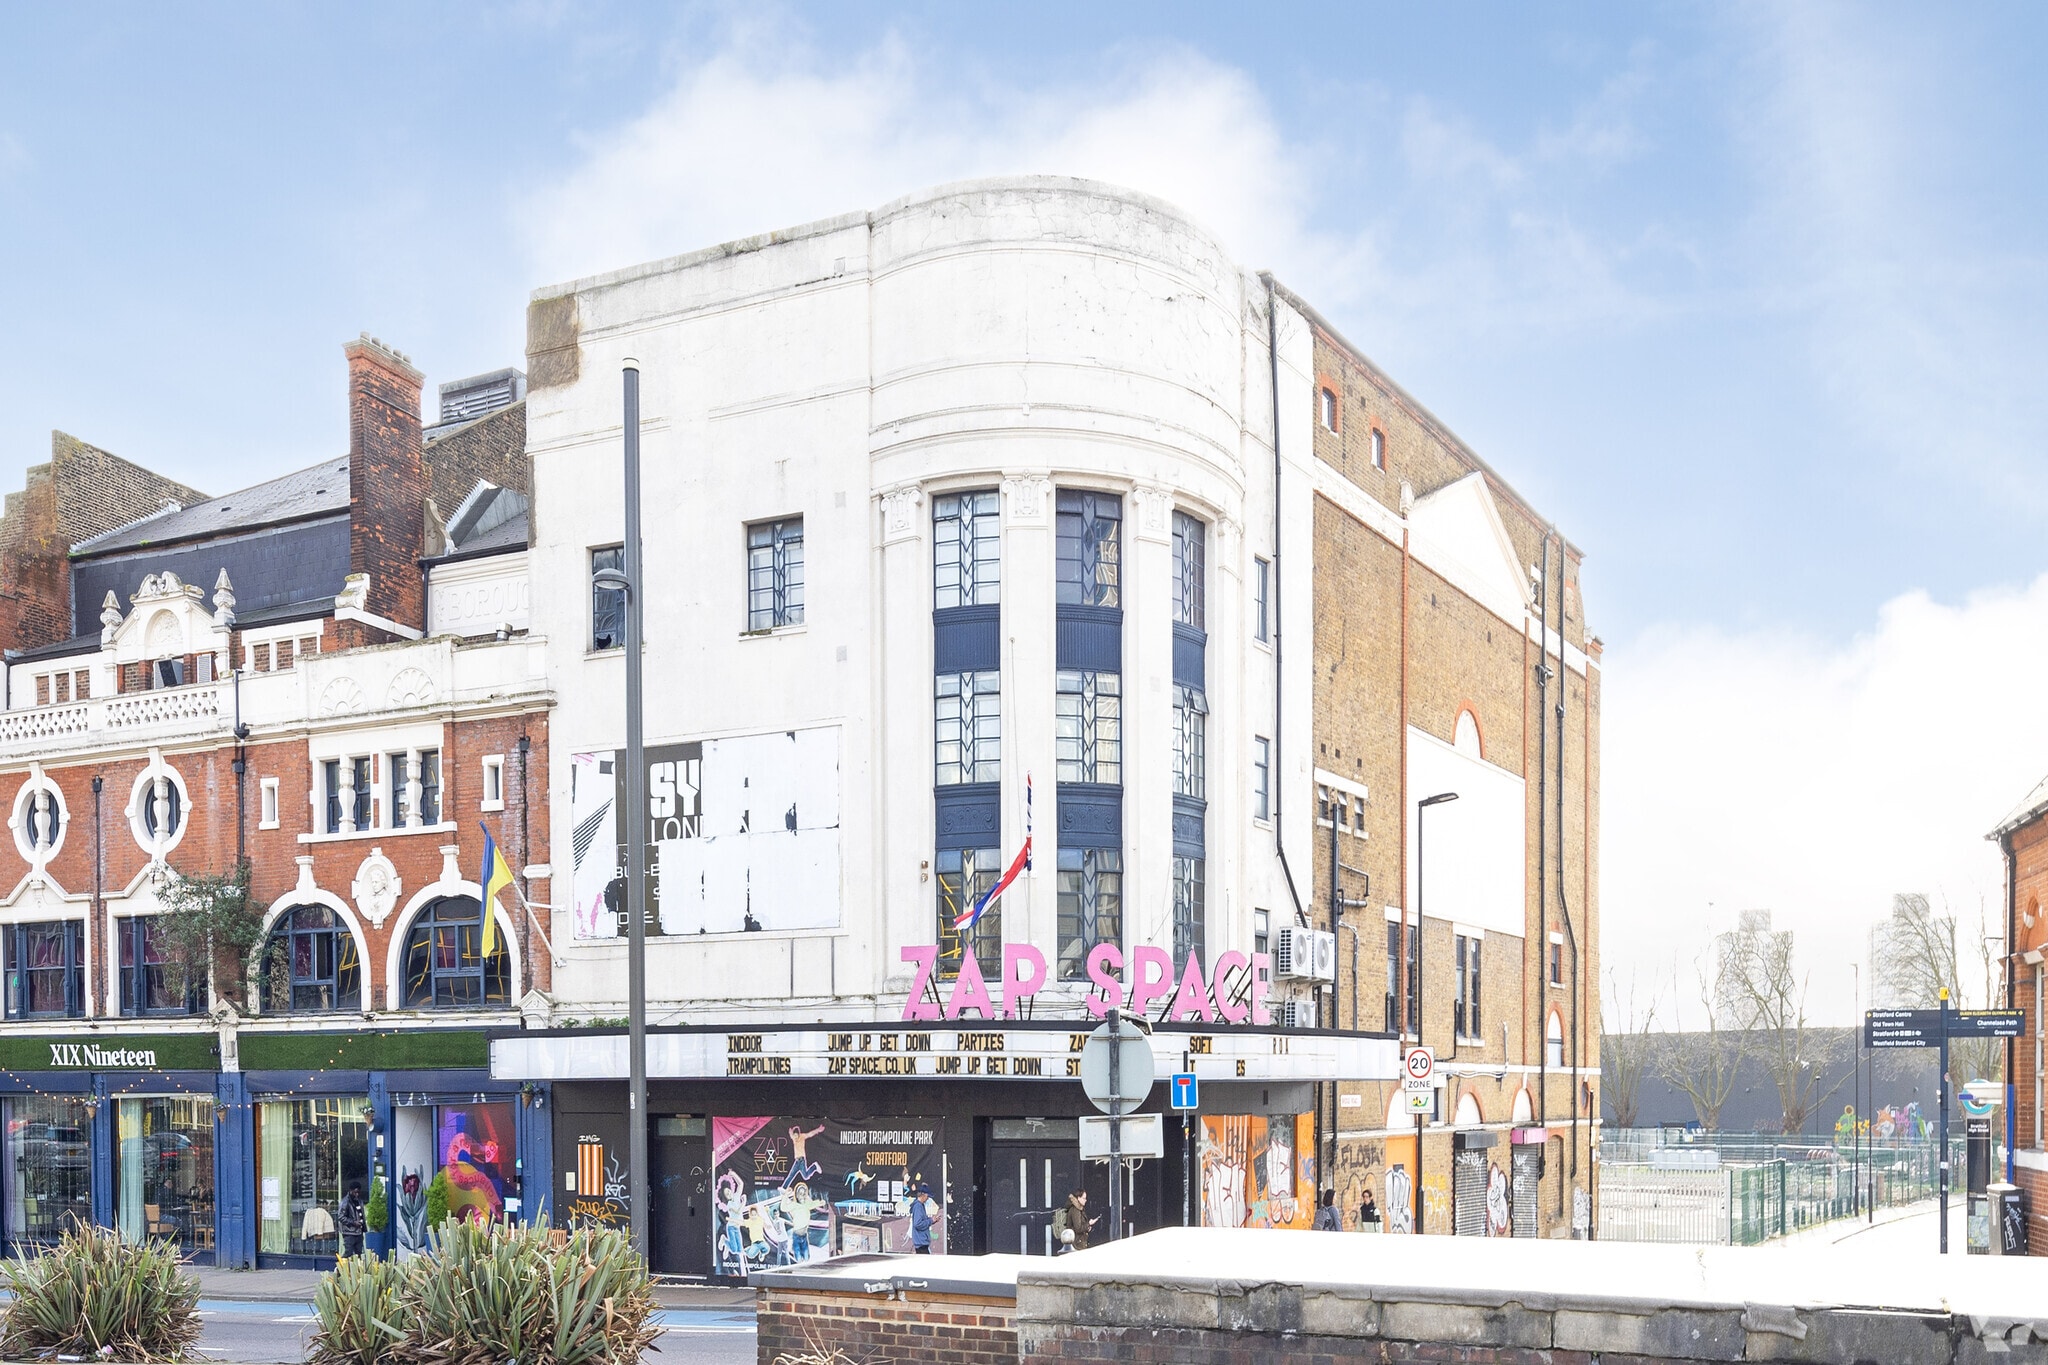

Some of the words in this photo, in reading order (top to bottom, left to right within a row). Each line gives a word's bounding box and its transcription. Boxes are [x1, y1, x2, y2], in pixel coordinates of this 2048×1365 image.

[650, 758, 703, 819] SY
[650, 815, 703, 846] LON
[901, 944, 1047, 1020] ZAP
[1086, 943, 1271, 1025] SPACE
[727, 1035, 762, 1051] INDOOR
[828, 1034, 852, 1051] JUMP
[858, 1034, 871, 1050] UP
[879, 1034, 899, 1050] GET
[905, 1034, 931, 1050] DOWN
[957, 1034, 1005, 1051] PARTIES
[1189, 1036, 1213, 1054] SOFT
[49, 1044, 82, 1066] XIX
[83, 1044, 156, 1066] Nineteen
[1411, 1057, 1428, 1069] 20
[727, 1057, 791, 1075] TRAMPOLINES
[828, 1057, 847, 1075] ZAP
[904, 1057, 917, 1075] UK
[935, 1057, 961, 1075] JUMP
[967, 1057, 981, 1074] UP
[986, 1057, 1007, 1075] GET
[1013, 1057, 1041, 1075] DOWN
[1066, 1058, 1081, 1077] ST
[1408, 1080, 1431, 1088] ZONE
[840, 1130, 868, 1145] INDOOR
[868, 1130, 913, 1145] TRAMPOLINE
[914, 1130, 934, 1145] PARK
[866, 1151, 908, 1166] STRATFORD
[848, 1202, 867, 1216] COME
[868, 1202, 877, 1216] IN
